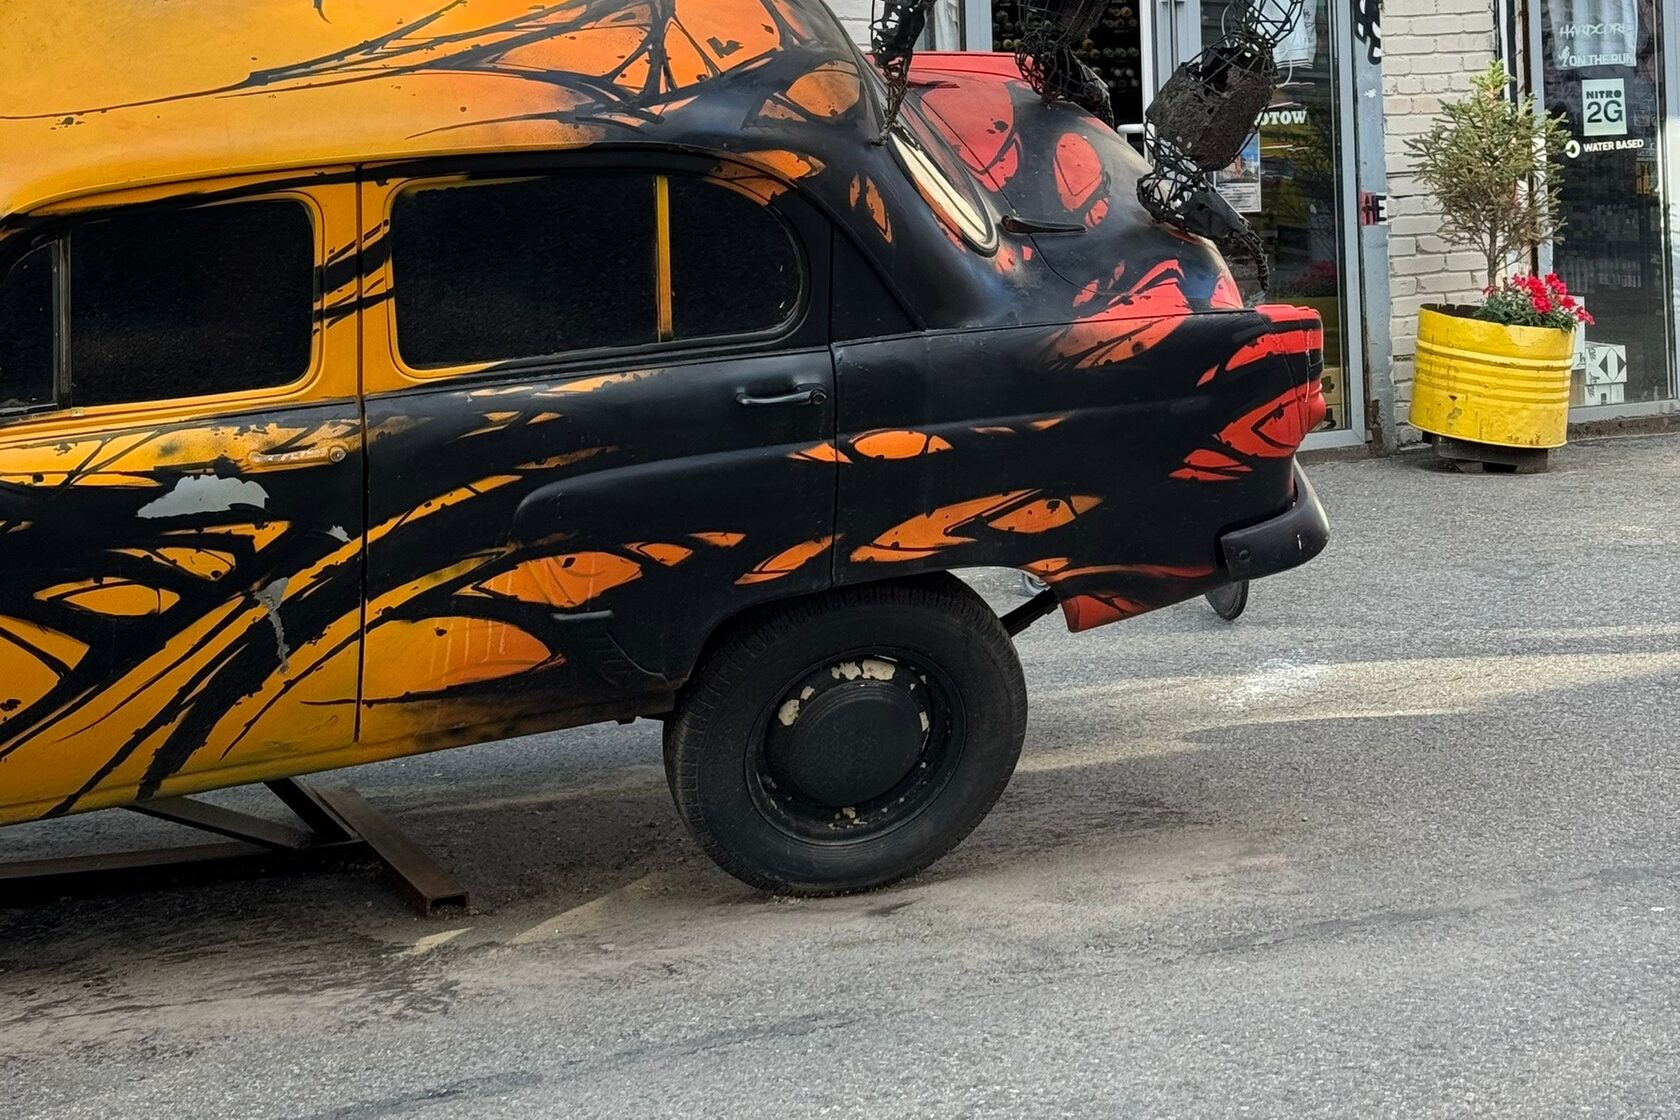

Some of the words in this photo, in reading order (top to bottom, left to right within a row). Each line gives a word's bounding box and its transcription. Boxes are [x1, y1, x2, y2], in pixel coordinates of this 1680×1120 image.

[1569, 54, 1586, 67] ON
[1589, 53, 1610, 65] THE
[1586, 89, 1622, 99] NITRO
[1254, 109, 1308, 126] OTOW
[1586, 99, 1623, 124] 2G
[1583, 141, 1614, 153] WATER
[1615, 138, 1645, 150] BASED
